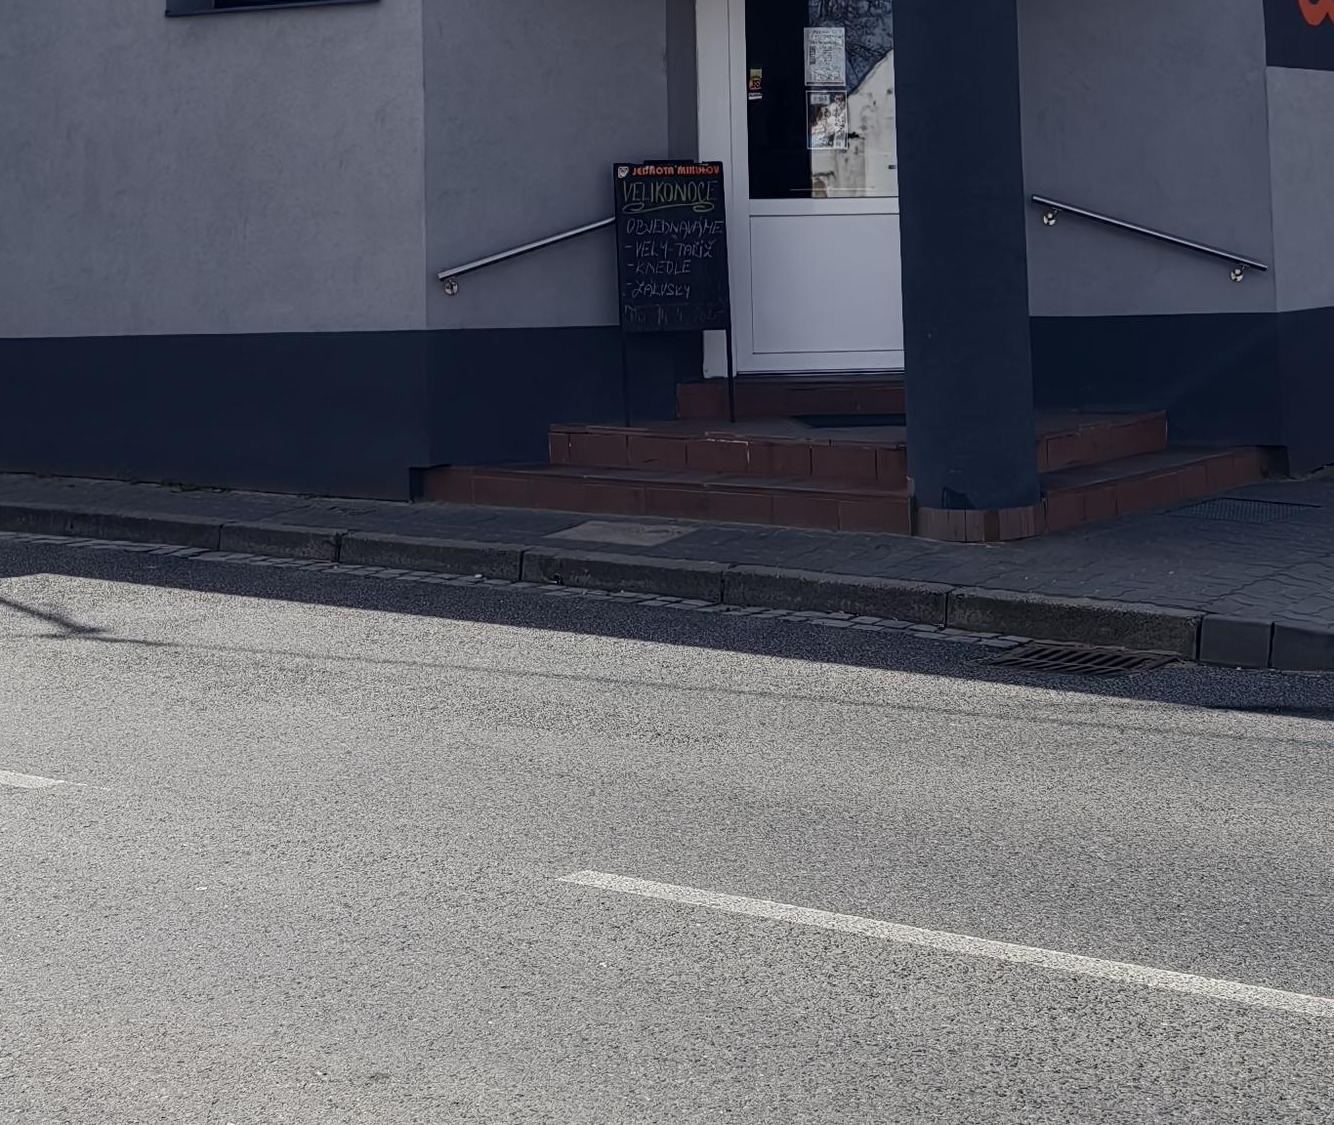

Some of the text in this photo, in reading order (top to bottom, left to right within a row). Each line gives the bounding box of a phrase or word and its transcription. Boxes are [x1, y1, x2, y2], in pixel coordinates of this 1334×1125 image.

[633, 165, 720, 176] JEDNOTA MIKULOV
[623, 180, 719, 203] VELIKONOCE
[635, 259, 691, 275] KNEDLE
